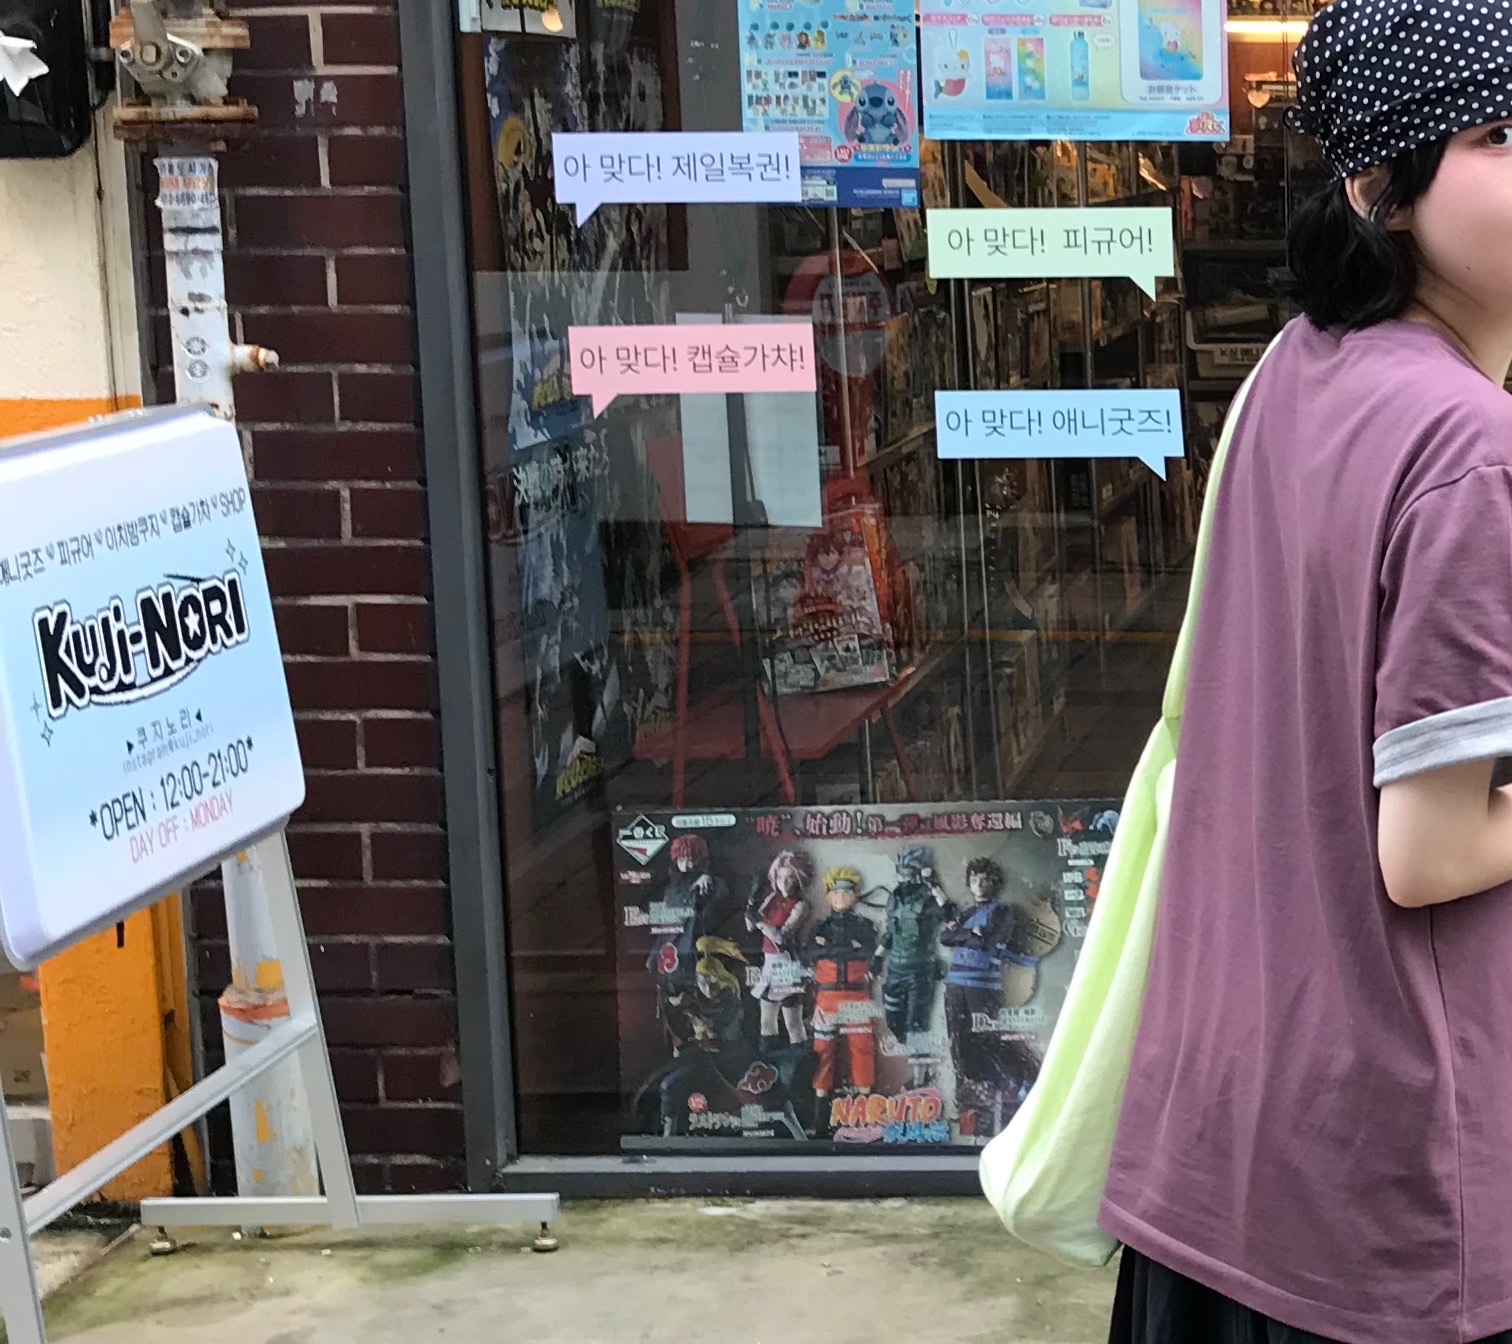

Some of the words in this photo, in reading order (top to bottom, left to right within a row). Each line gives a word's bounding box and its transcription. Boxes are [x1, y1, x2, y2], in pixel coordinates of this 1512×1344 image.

[563, 152, 590, 183] 아
[599, 152, 662, 183] 맞다!
[671, 152, 790, 184] 제일복권!
[947, 227, 974, 256] 아
[984, 227, 1046, 256] 맞다!
[1063, 225, 1153, 256] 피규어!
[579, 345, 606, 375] 아
[615, 344, 678, 375] 맞다!
[687, 343, 806, 374] 캡슐가챠!
[946, 409, 973, 437] 아
[981, 408, 1044, 437] 맞다!
[1052, 407, 1172, 436] 애니굿즈!
[57, 532, 95, 568] 피규어
[218, 487, 247, 519] SHOP
[129, 826, 155, 864] DAY
[157, 814, 180, 849] OFF
[189, 787, 234, 832] MONDAY
[829, 1093, 942, 1128] NARUTO
